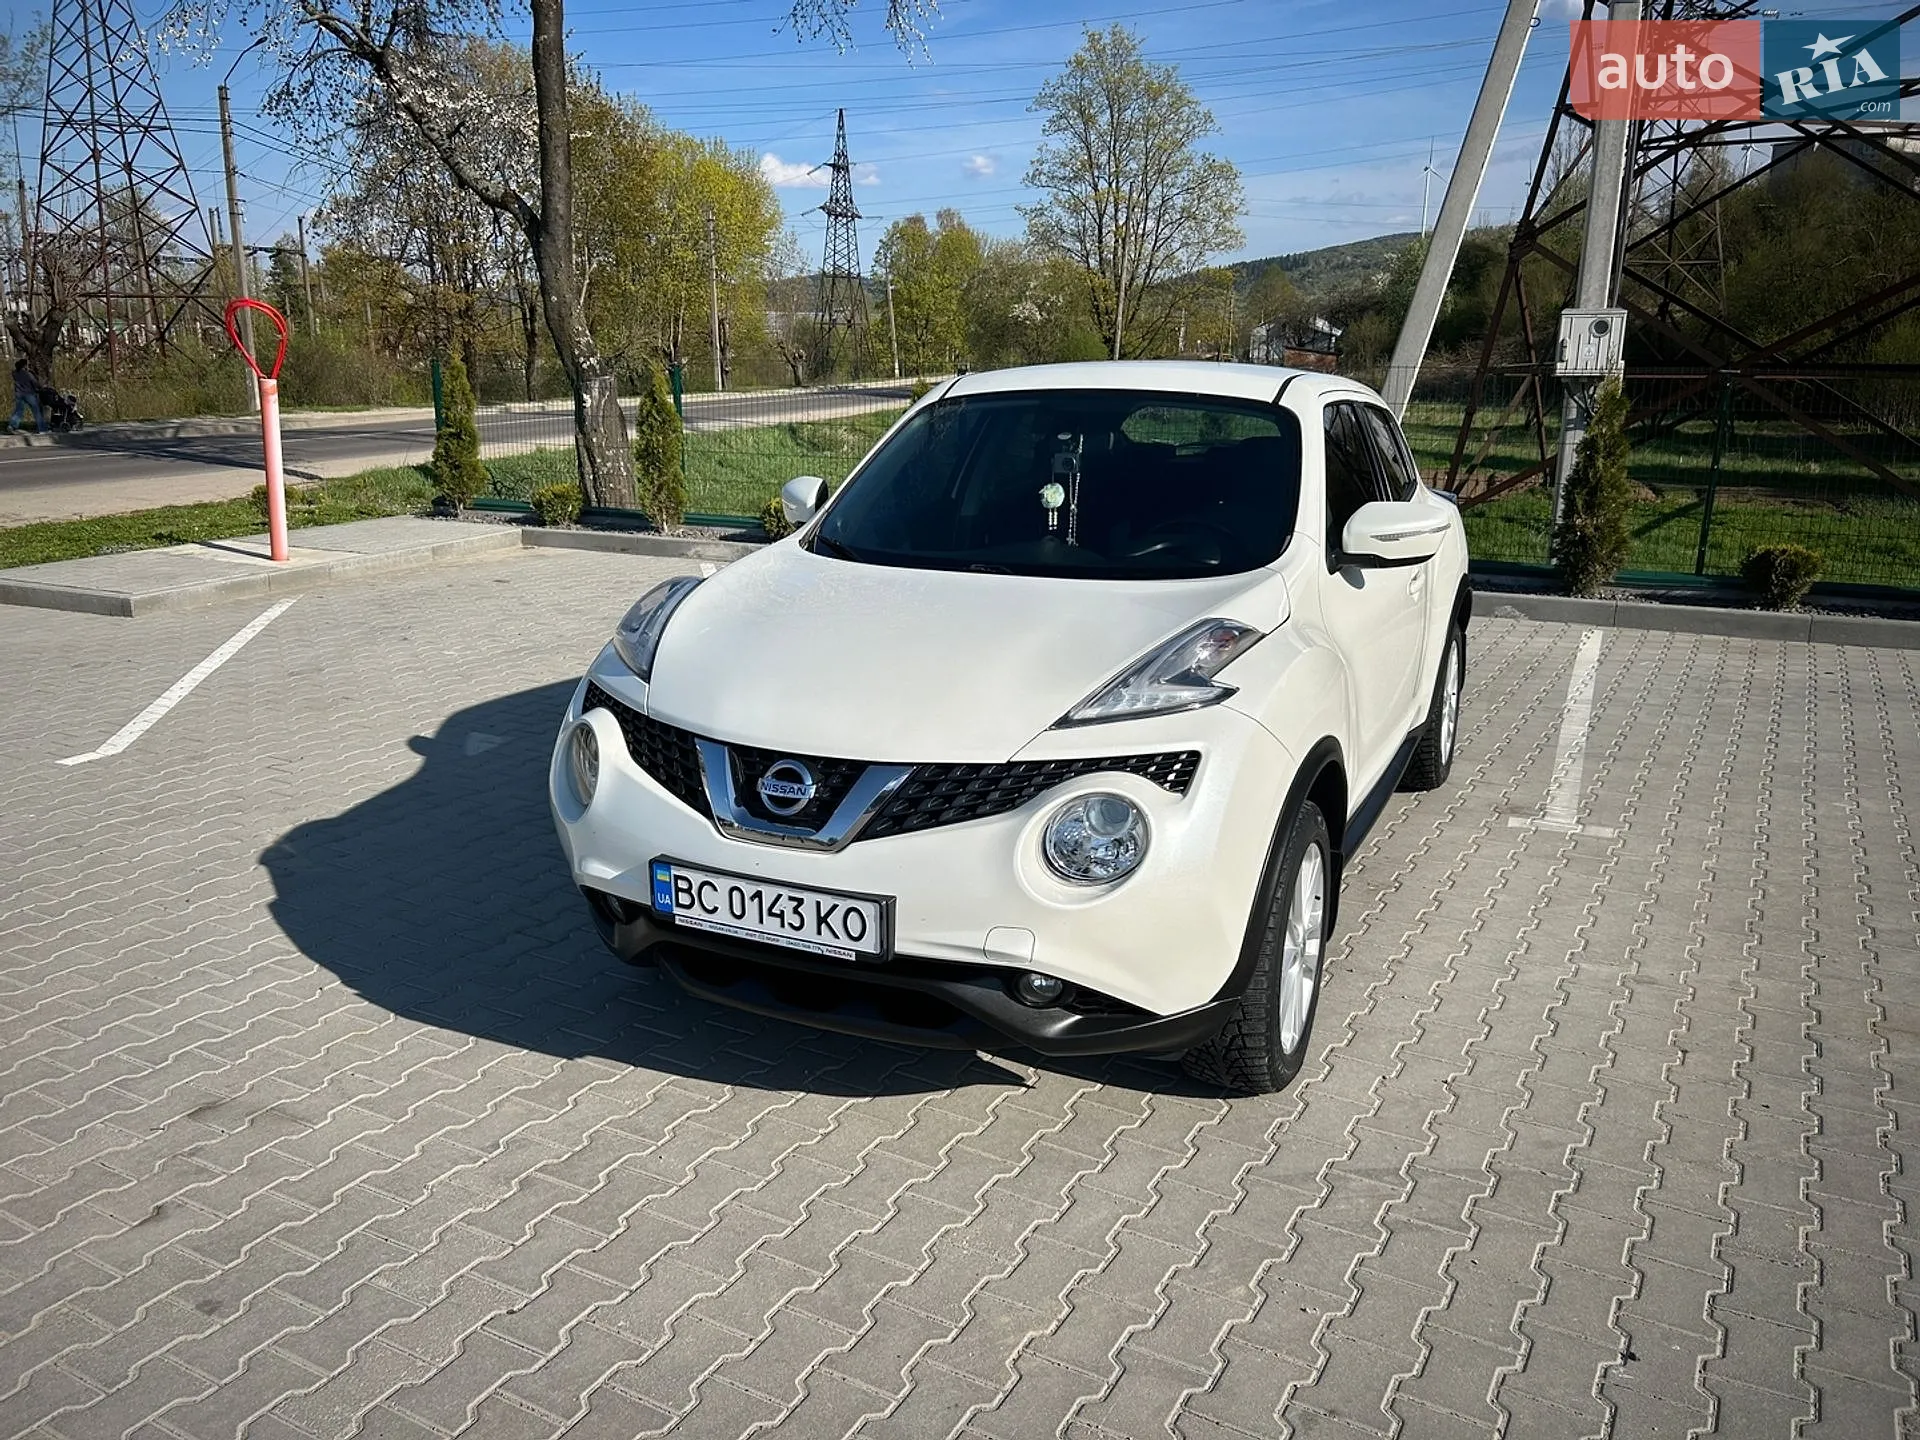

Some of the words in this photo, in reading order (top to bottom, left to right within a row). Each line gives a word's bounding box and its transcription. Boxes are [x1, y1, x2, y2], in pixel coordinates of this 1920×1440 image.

[761, 781, 807, 796] NISSAN
[657, 893, 671, 905] UA
[673, 874, 719, 914] BC
[728, 885, 805, 931] 0143
[816, 900, 868, 943] KO
[678, 917, 703, 928] NISSAN
[825, 947, 853, 958] NISSAN
